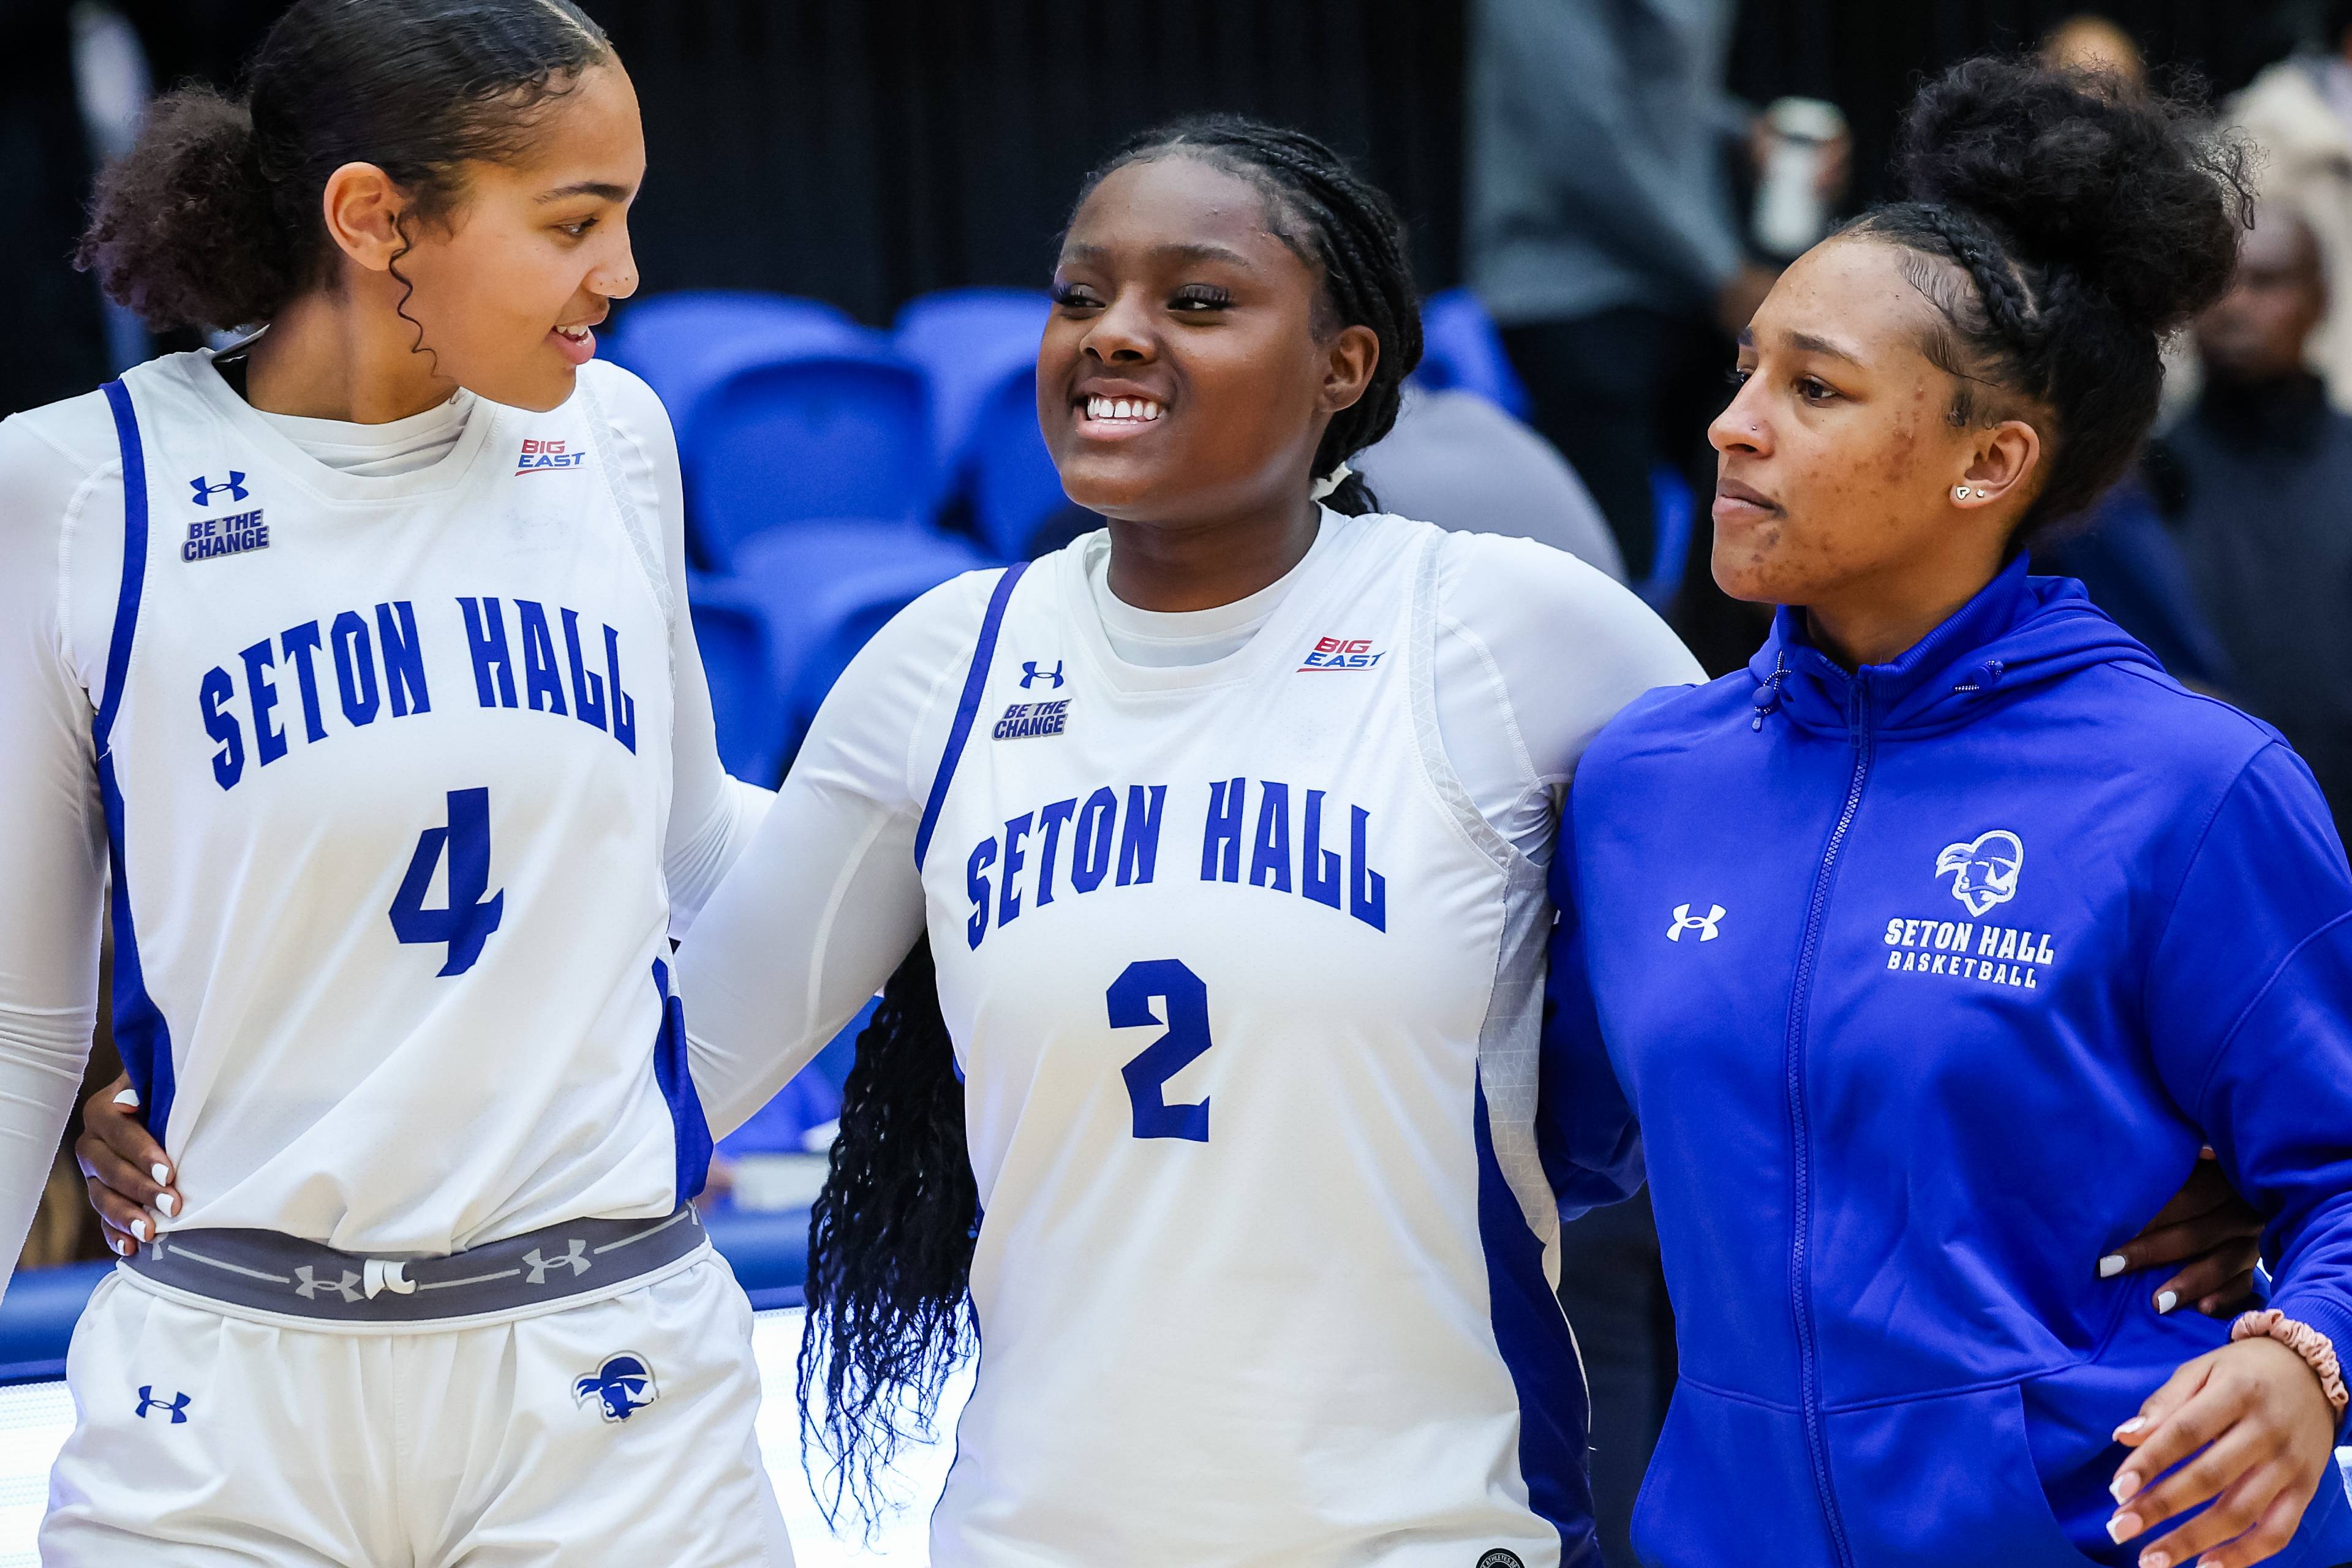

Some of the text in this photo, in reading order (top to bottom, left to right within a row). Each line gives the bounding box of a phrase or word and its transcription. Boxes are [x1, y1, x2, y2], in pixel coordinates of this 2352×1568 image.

[518, 452, 586, 468] EAST
[521, 439, 565, 454] BIG
[189, 510, 262, 540] BE THE
[184, 527, 268, 562] CHANGE
[1303, 650, 1387, 668] EAST
[1314, 636, 1373, 654] BIG
[199, 597, 637, 792] SETON HALL
[1003, 699, 1070, 719] BE THE
[993, 714, 1066, 739] CHANGE
[967, 777, 1386, 952] SETON HALL
[388, 786, 504, 978] 4
[1883, 918, 2054, 965] SETON HALL
[1886, 950, 2037, 989] BASKETBALL
[1106, 958, 1213, 1144] 2
[1485, 1554, 1511, 1566] ATHLETES
